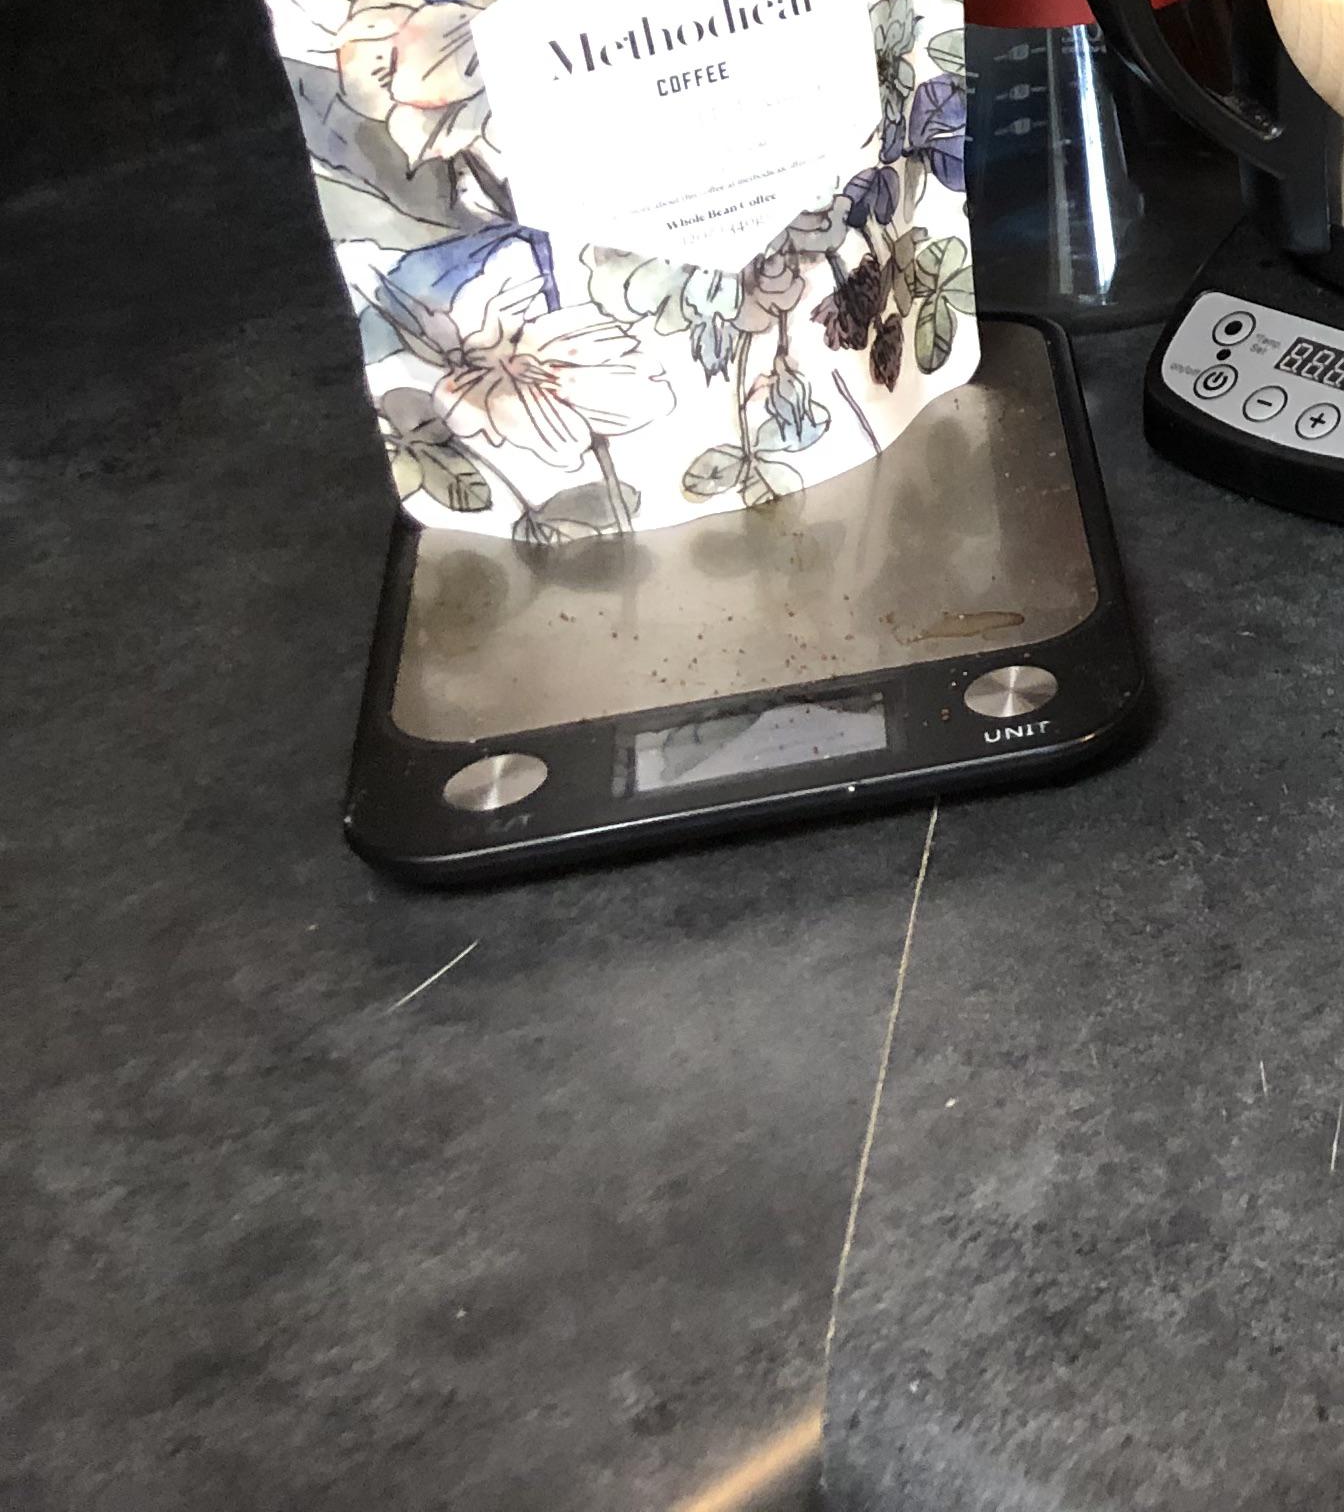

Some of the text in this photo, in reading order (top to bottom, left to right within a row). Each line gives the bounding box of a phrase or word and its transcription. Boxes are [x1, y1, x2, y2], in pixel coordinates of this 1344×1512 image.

[657, 62, 729, 96] COFFEE
[708, 205, 738, 220] Bean
[984, 721, 1051, 743] UNIT
